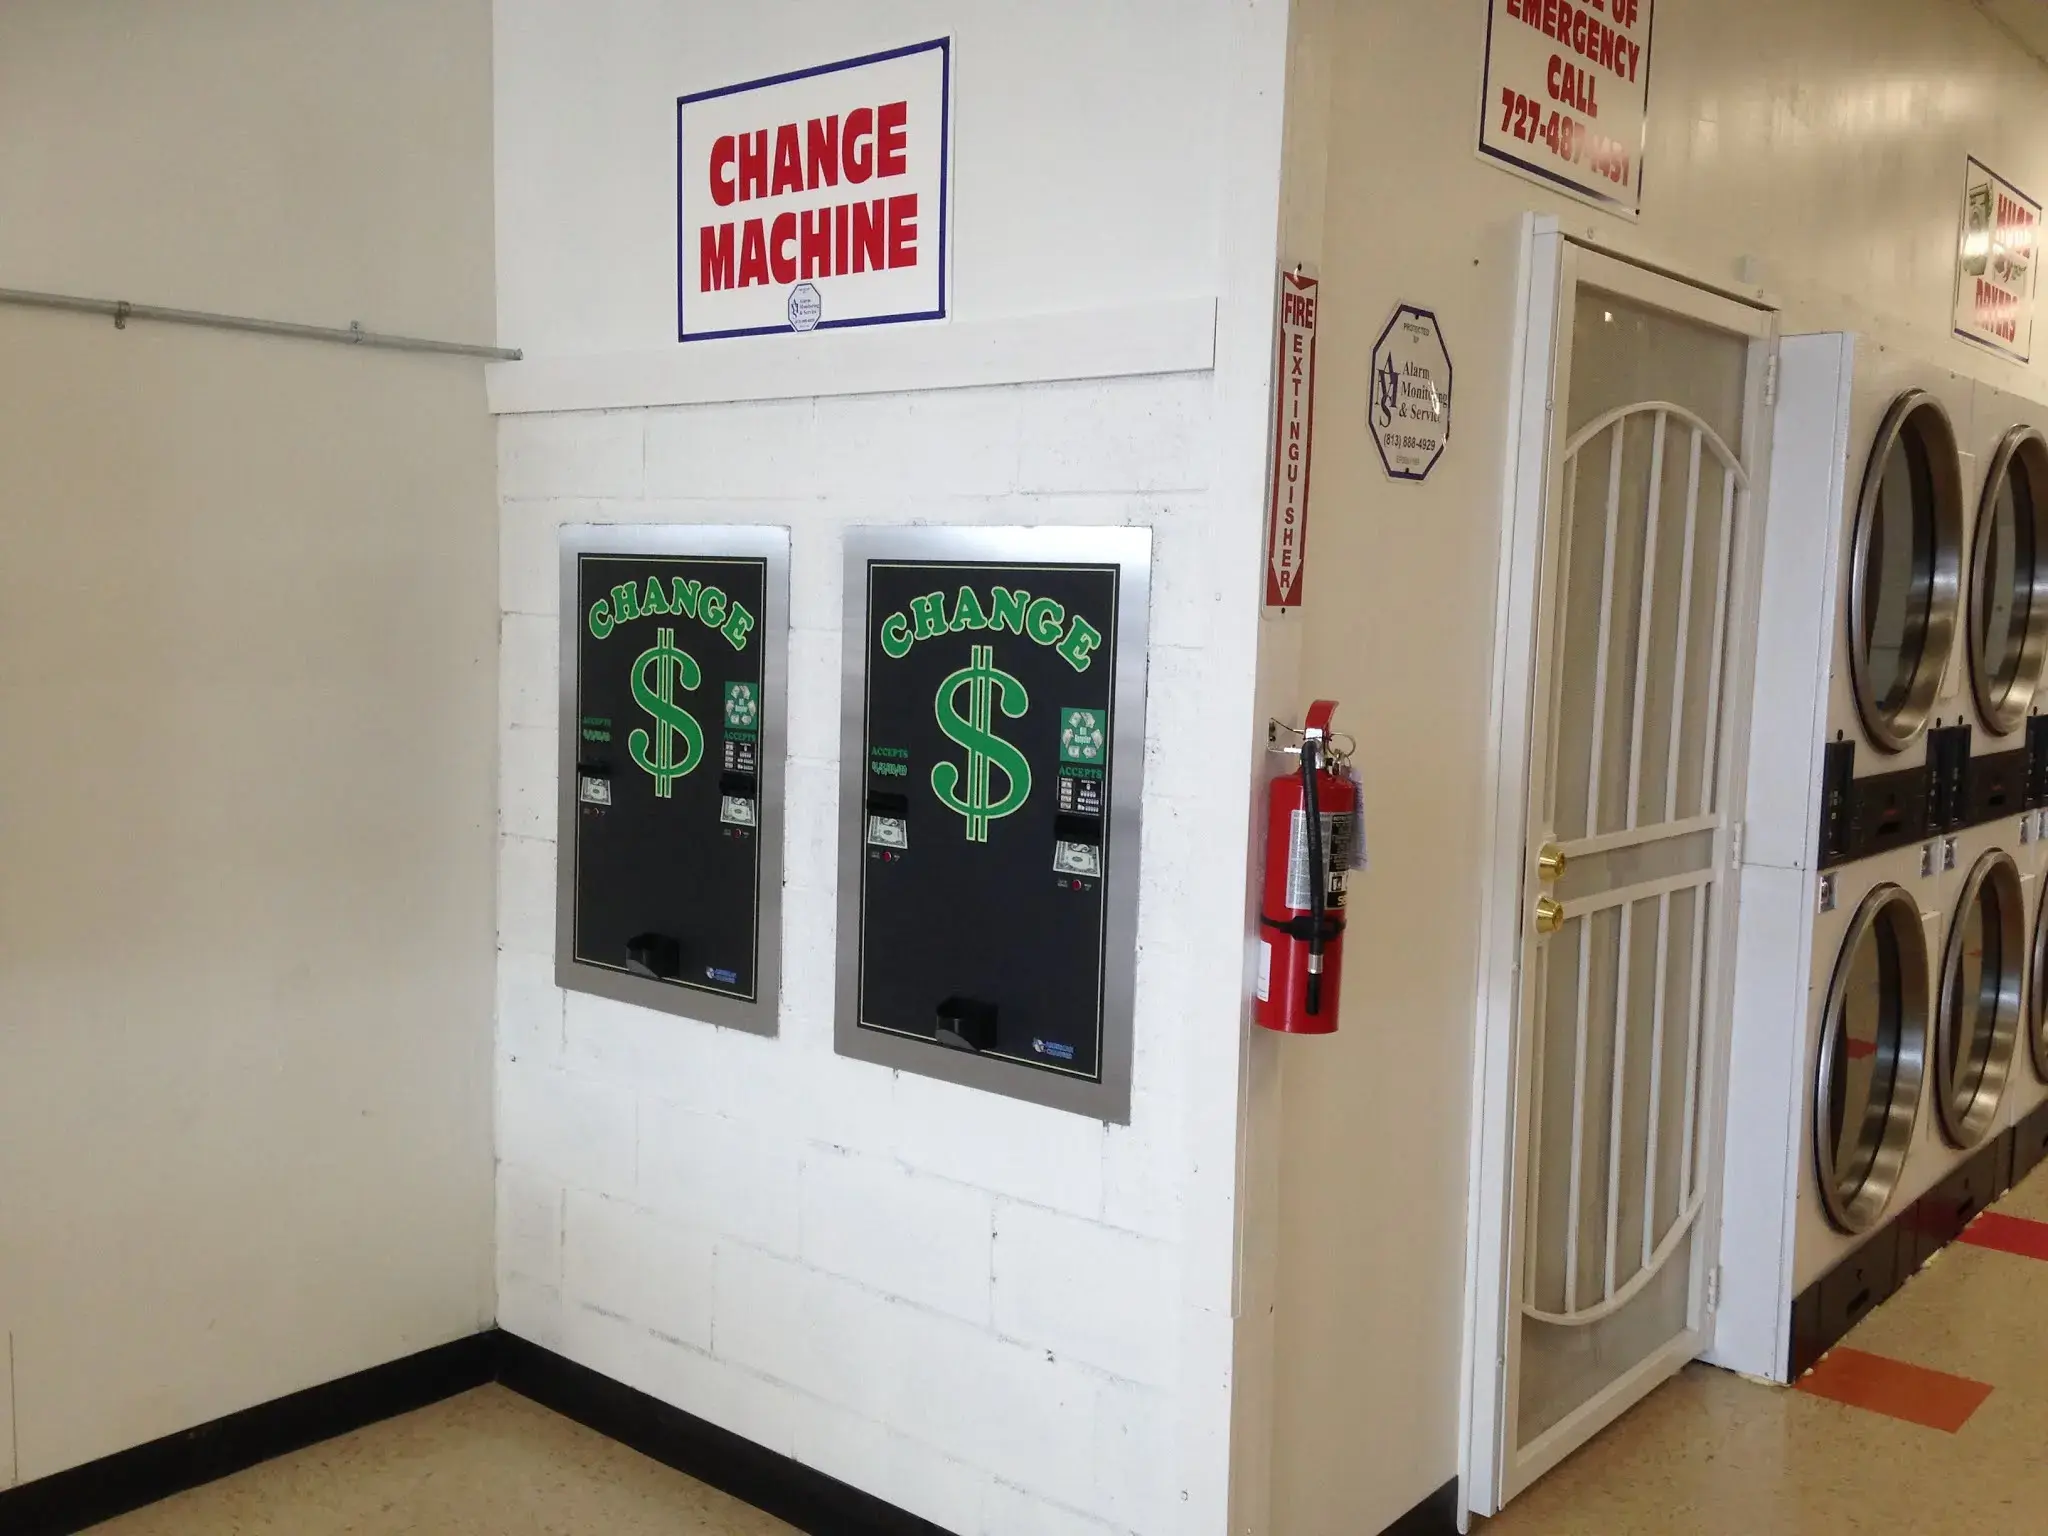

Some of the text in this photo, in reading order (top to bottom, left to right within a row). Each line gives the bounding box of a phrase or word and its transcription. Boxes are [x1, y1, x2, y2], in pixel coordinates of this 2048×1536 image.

[1547, 54, 1598, 119] CALL
[709, 101, 907, 207] CHANGE
[700, 193, 918, 292] MACHINE
[1284, 293, 1314, 330] FIRE
[1403, 361, 1430, 380] Alarm
[1399, 402, 1408, 418] &
[1401, 381, 1448, 408] Monitoing
[1383, 432, 1436, 451] (813) 888-4929
[1279, 333, 1303, 589] EXTINGUISHER
[588, 576, 754, 651] CHANGE
[881, 586, 1102, 672] CHANGE
[871, 746, 908, 759] ACCEPTS
[1059, 765, 1103, 779] ACCEPTS
